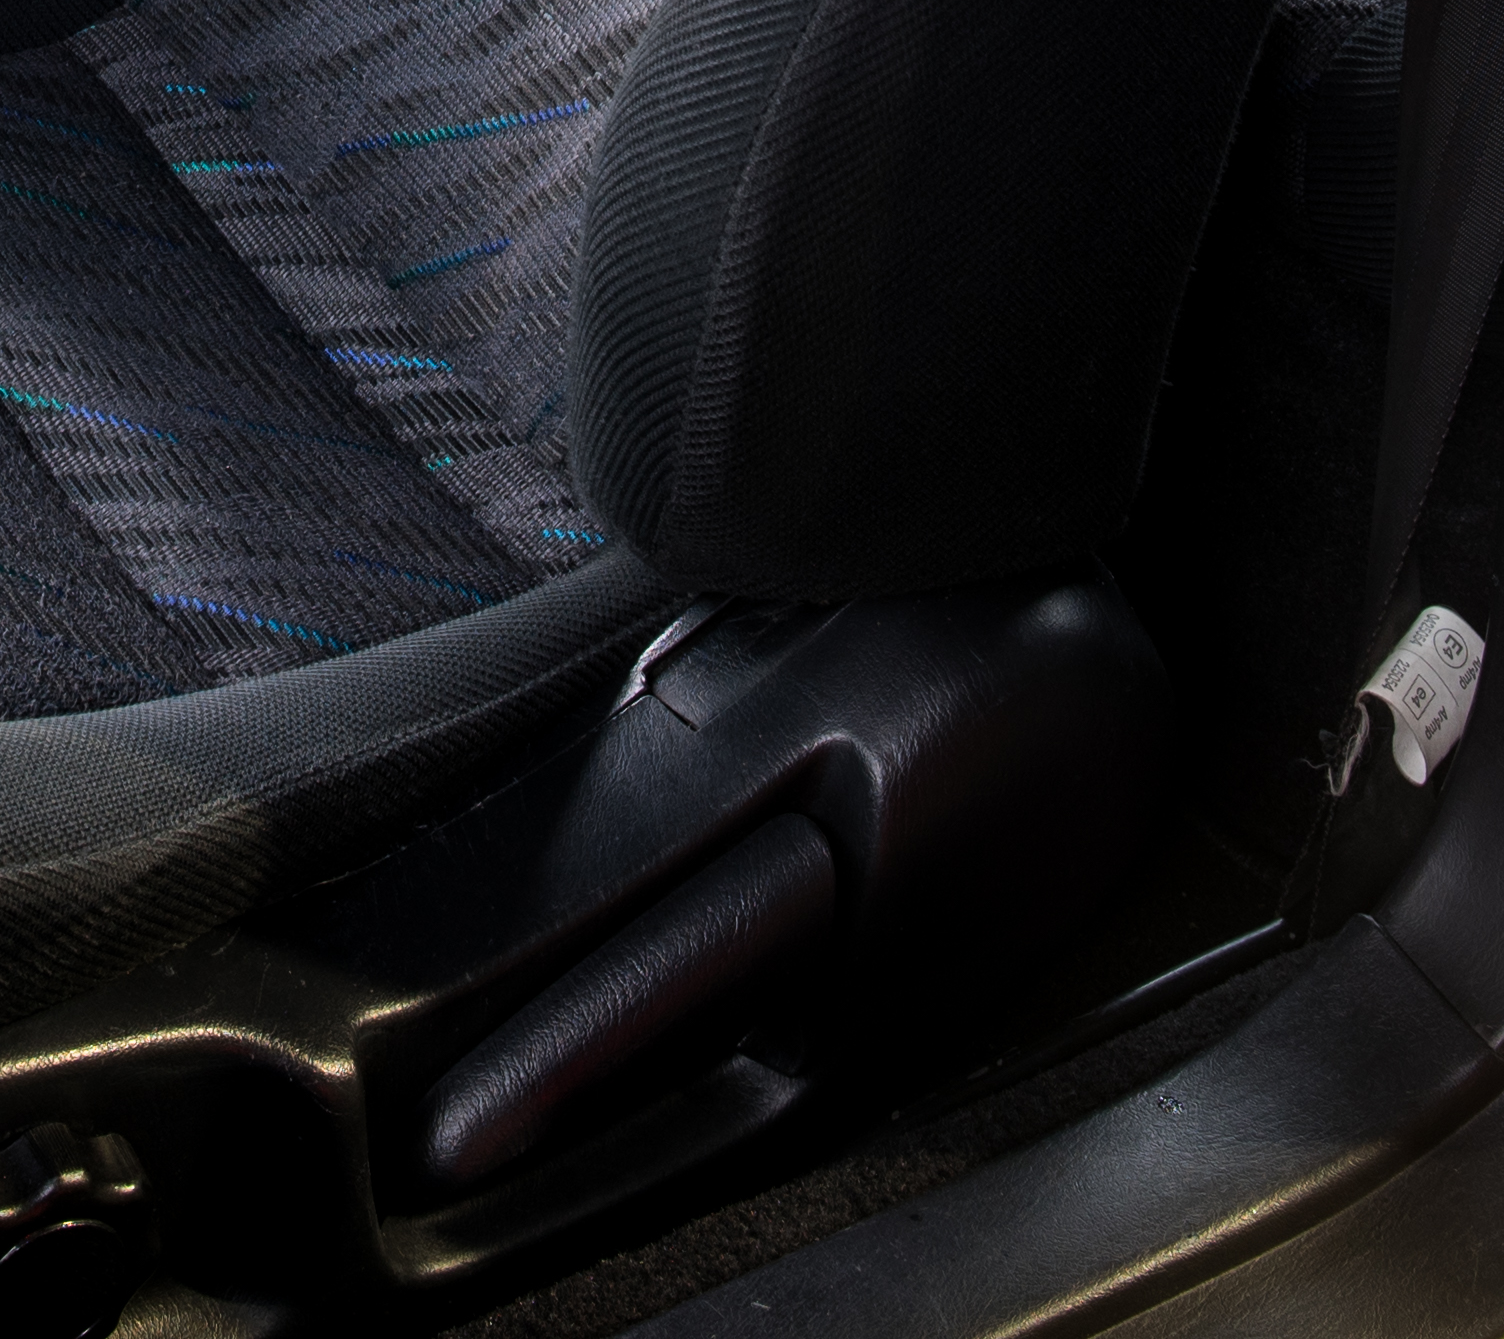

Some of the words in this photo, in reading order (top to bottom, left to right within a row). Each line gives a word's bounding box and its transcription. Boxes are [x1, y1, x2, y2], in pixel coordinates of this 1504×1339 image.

[1442, 634, 1463, 661] E4
[1412, 686, 1427, 709] e4
[1424, 705, 1449, 740] Ar4mp
